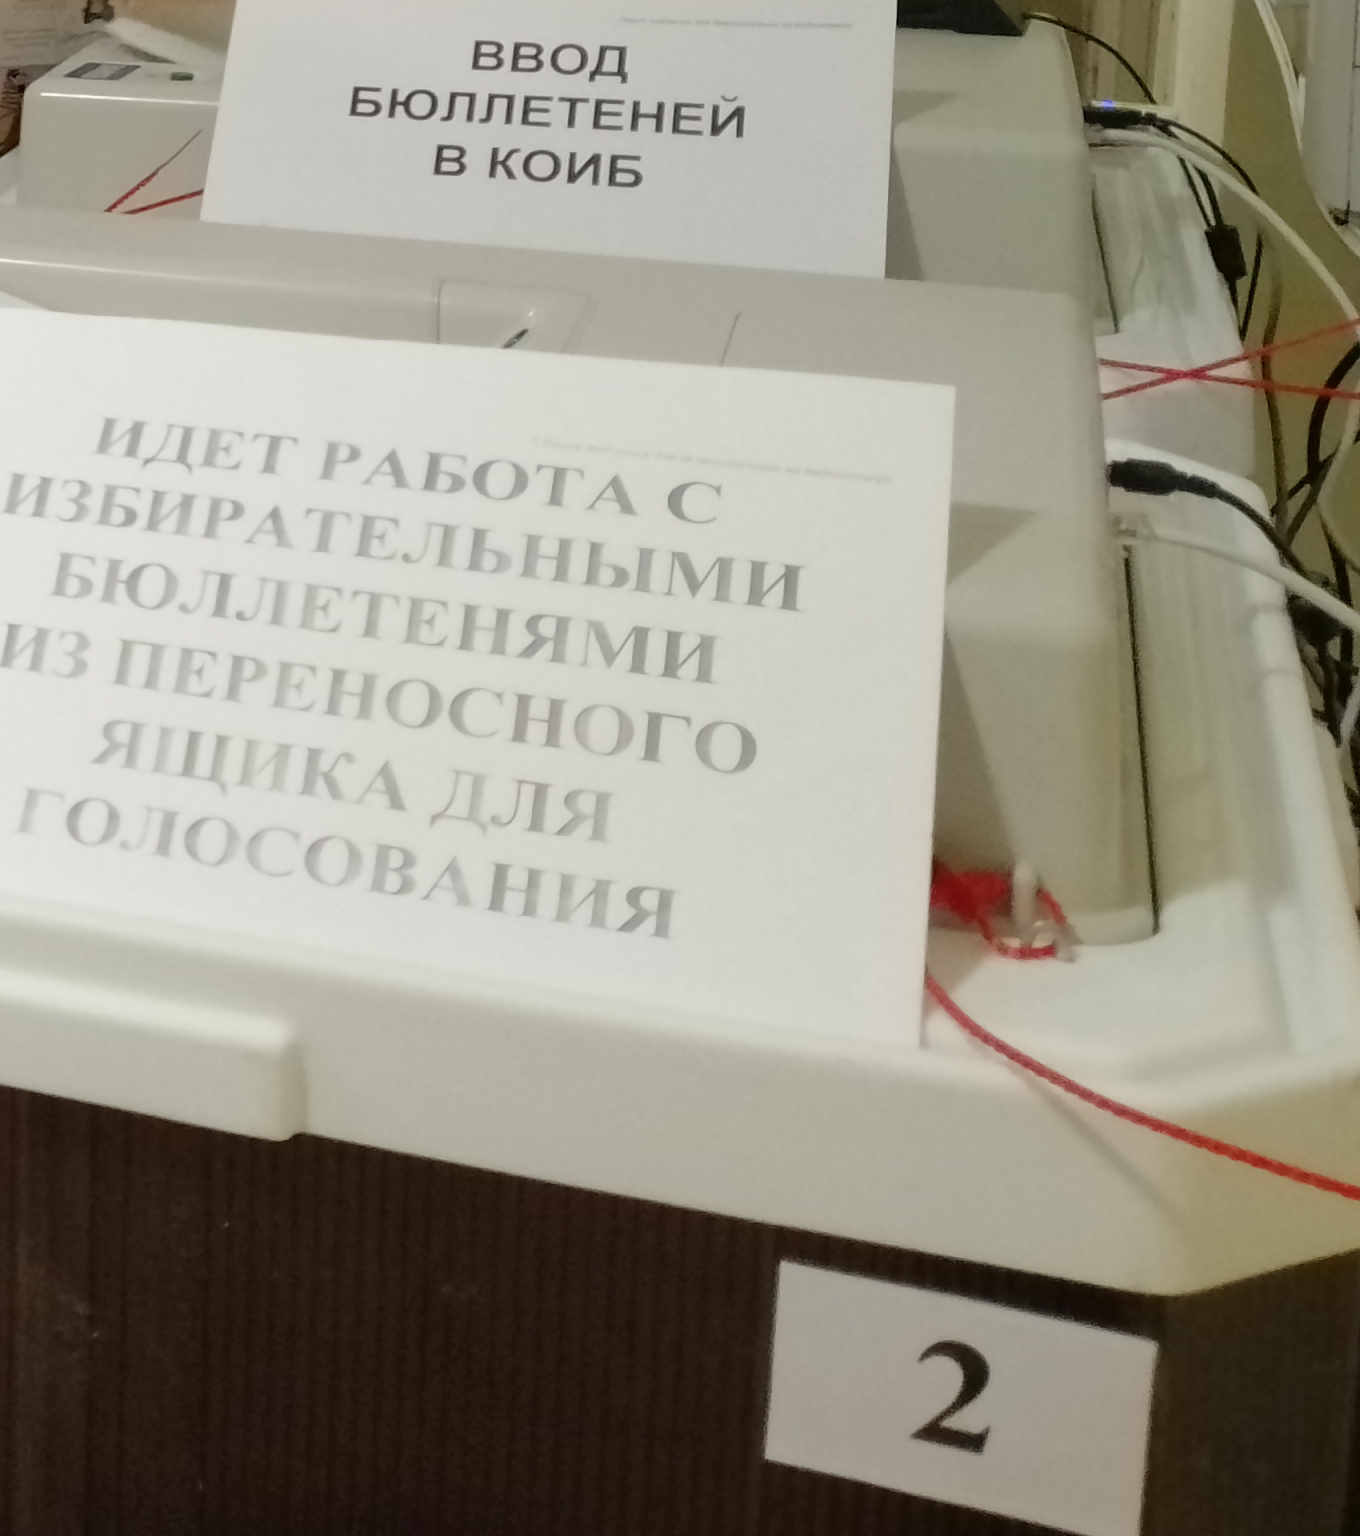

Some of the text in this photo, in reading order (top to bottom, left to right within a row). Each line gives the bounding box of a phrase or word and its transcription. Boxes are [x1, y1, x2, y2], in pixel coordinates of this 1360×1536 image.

[348, 85, 746, 139] БЮЛЛЕТЕНЕЙ
[470, 40, 629, 83] ВВОД
[433, 144, 644, 188] В КОИБ
[93, 415, 300, 476] ИДЕТ
[317, 439, 641, 519] РАБОТА
[666, 479, 724, 525] С
[0, 470, 807, 613] ИЗБИРАТЕЛЬНЫМИ
[49, 550, 719, 685] БЮЛЛЕТЕНЯМИ
[112, 637, 760, 776] ПЕРЕНОСНОГО
[90, 718, 615, 843] ЯЩИКА ДЛЯ
[14, 788, 678, 940] ГОЛОСОВАНИЯ
[911, 1340, 990, 1455] 2
